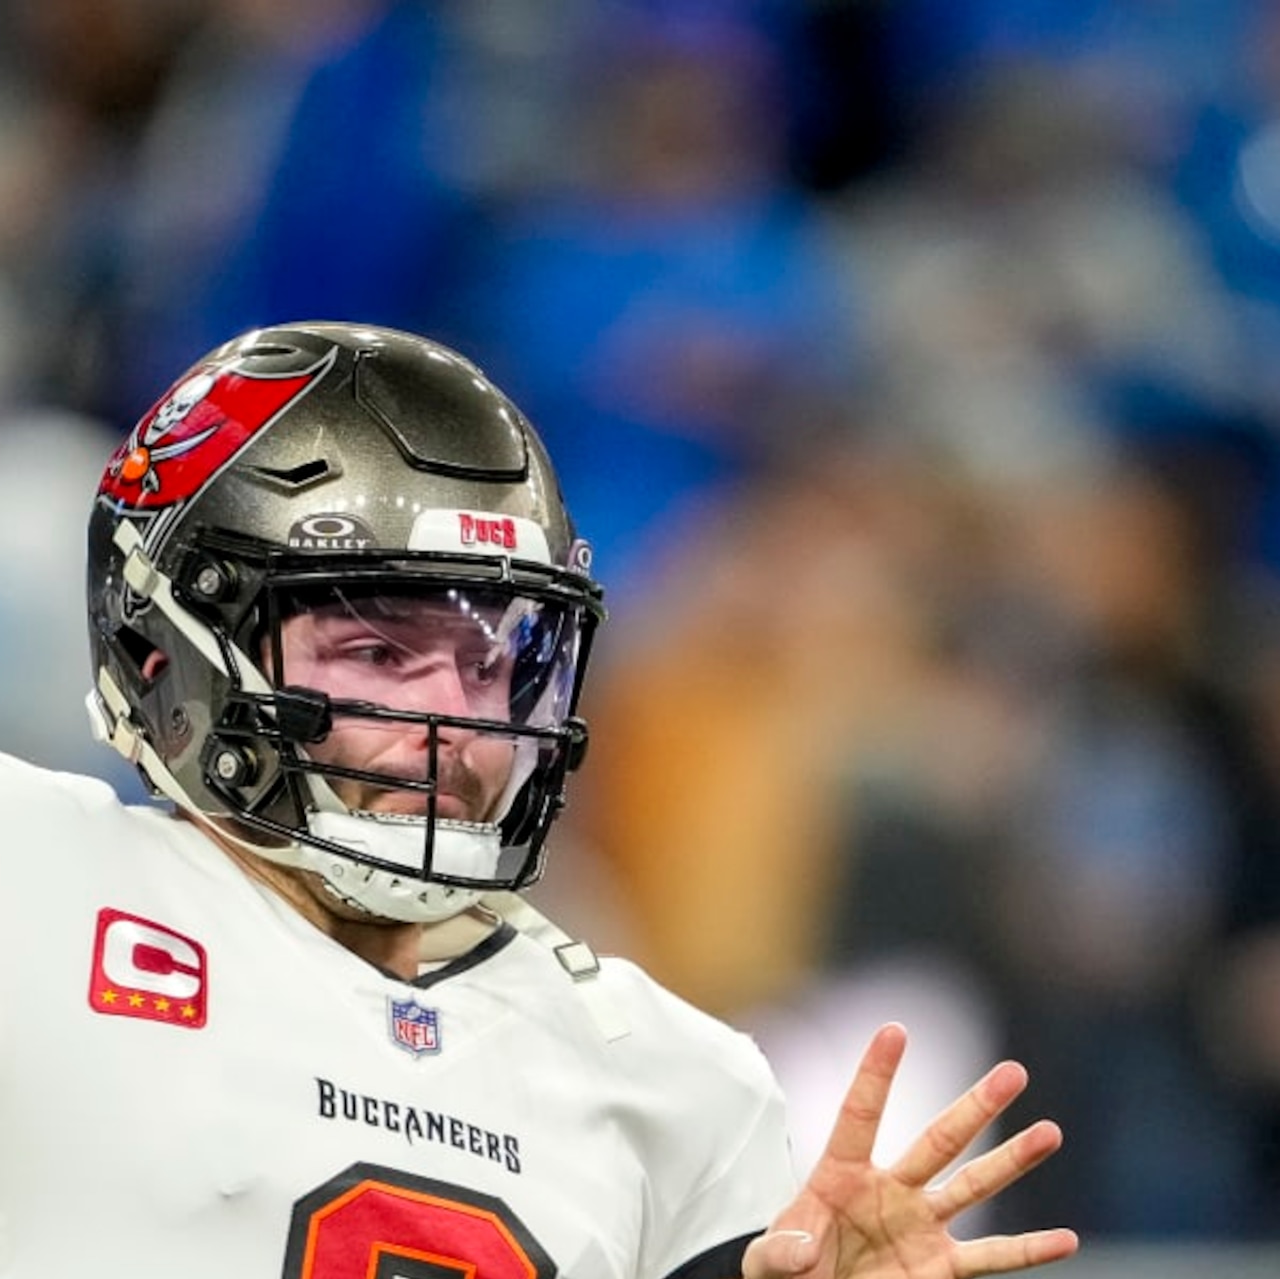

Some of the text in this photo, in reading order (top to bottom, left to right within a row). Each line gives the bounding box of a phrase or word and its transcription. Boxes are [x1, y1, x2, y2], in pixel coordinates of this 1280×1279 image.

[289, 538, 368, 549] OAKLEY
[102, 918, 201, 1000] C
[396, 1019, 434, 1047] NFL
[315, 1077, 521, 1174] BUCCANEERS
